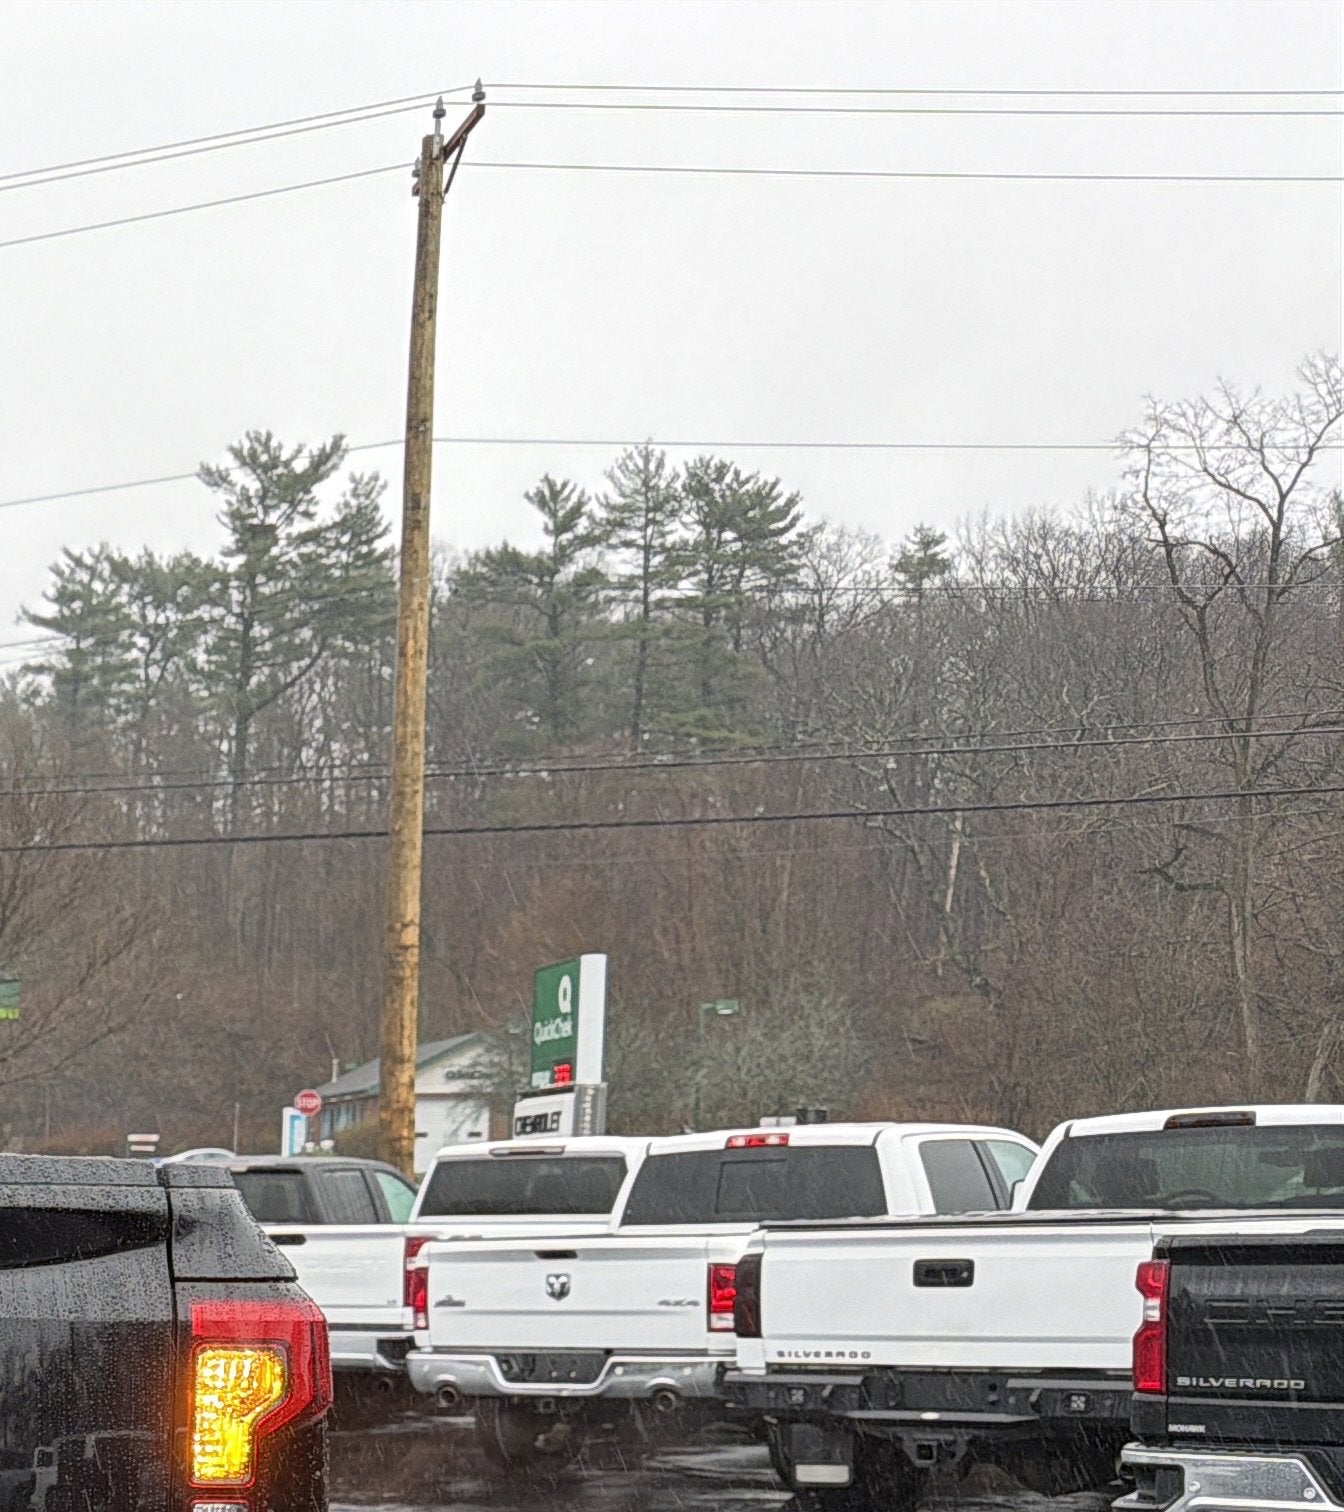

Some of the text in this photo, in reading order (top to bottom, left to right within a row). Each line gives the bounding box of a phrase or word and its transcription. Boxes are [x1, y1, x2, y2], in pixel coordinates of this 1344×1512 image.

[534, 1014, 573, 1046] QuickChek
[296, 1096, 320, 1109] STOP
[776, 1350, 872, 1360] SILVERADO
[1176, 1376, 1306, 1390] SILVERADO
